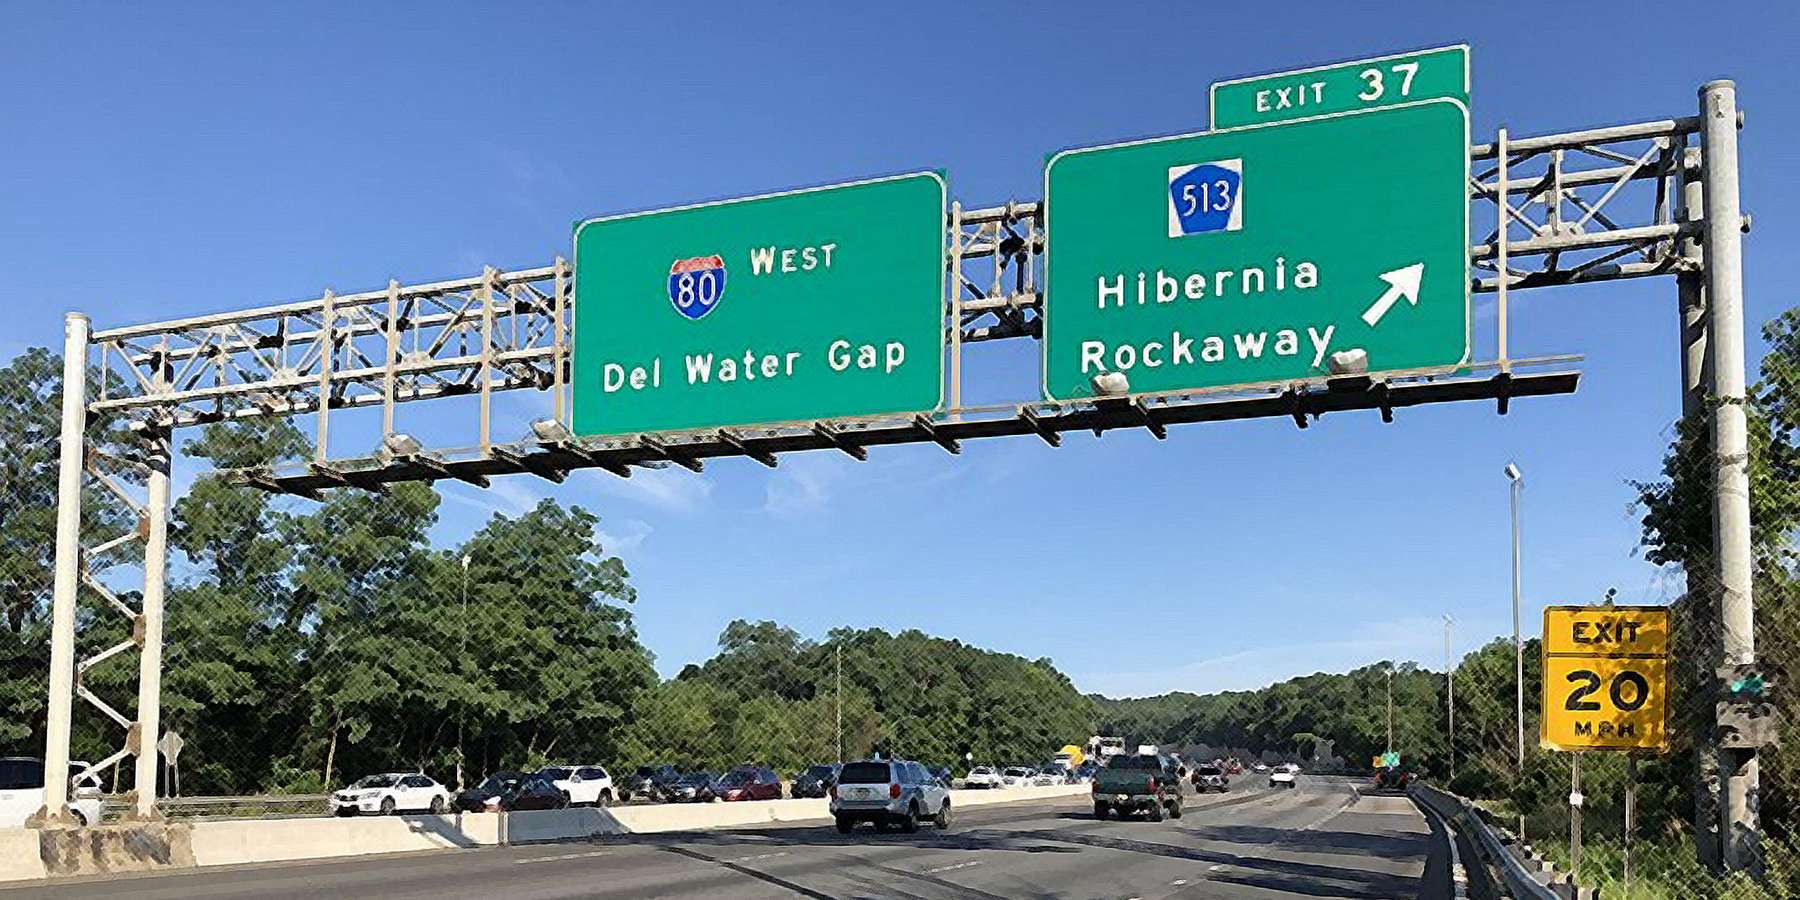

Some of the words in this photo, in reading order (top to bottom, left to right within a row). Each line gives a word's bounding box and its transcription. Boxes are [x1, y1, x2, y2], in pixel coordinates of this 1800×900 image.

[1256, 82, 1326, 112] EXIT
[1358, 62, 1420, 101] 37
[1181, 180, 1231, 217] 513
[750, 243, 837, 275] WEST
[678, 273, 716, 308] 80
[1097, 257, 1319, 308] Hibernia
[603, 358, 660, 392] Del
[685, 349, 801, 384] Water
[828, 340, 905, 373] Gap
[1081, 324, 1335, 373] Rockaway
[1572, 621, 1640, 644] EXIT
[1565, 670, 1649, 711] 20
[1574, 720, 1635, 738] MPH
